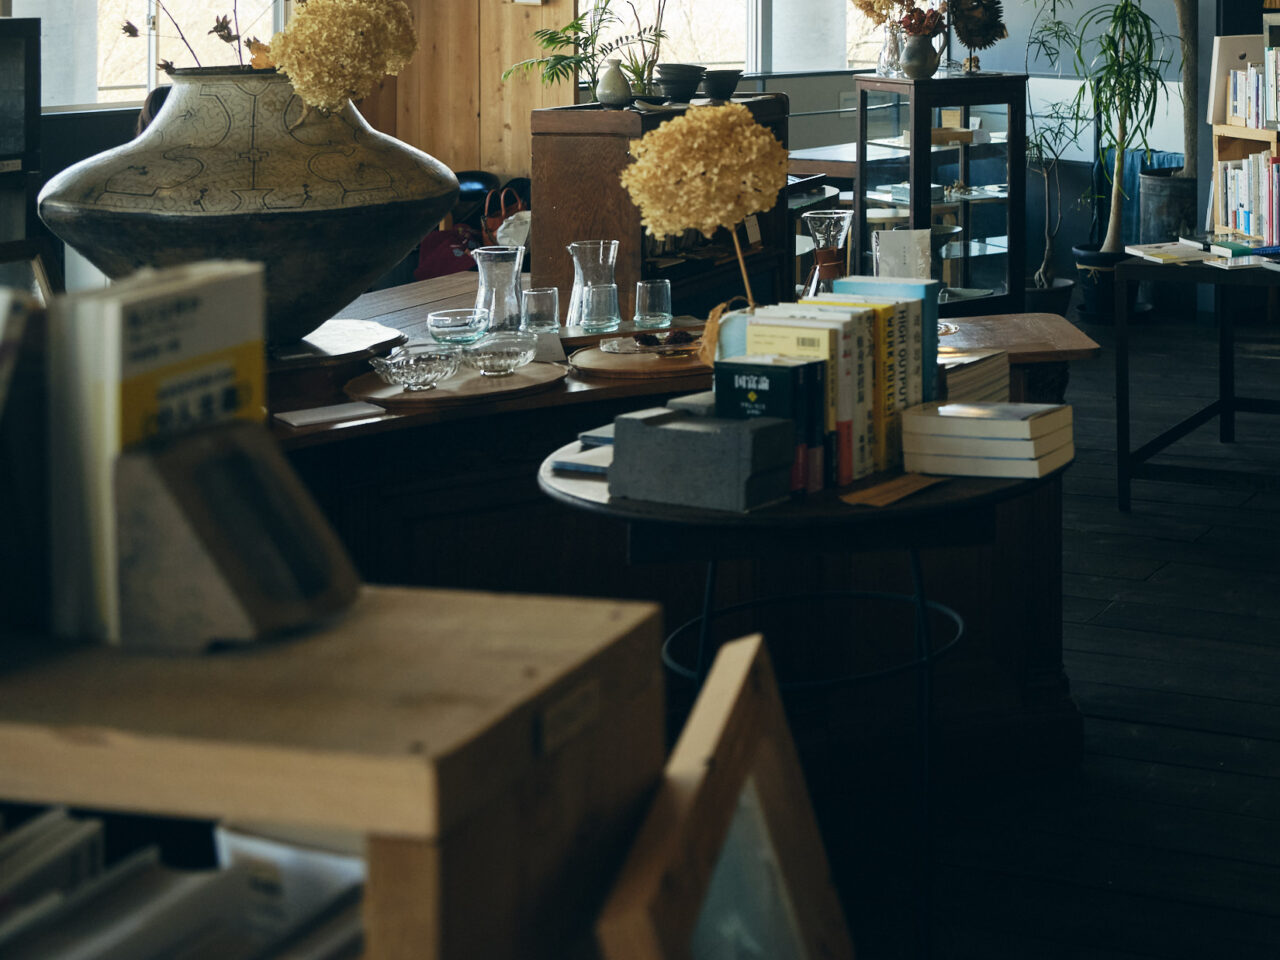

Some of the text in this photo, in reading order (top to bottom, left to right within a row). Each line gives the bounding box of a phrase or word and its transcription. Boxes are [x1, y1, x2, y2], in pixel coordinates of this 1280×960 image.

[887, 316, 895, 358] WORK
[898, 309, 908, 406] HIGH OUTPUT
